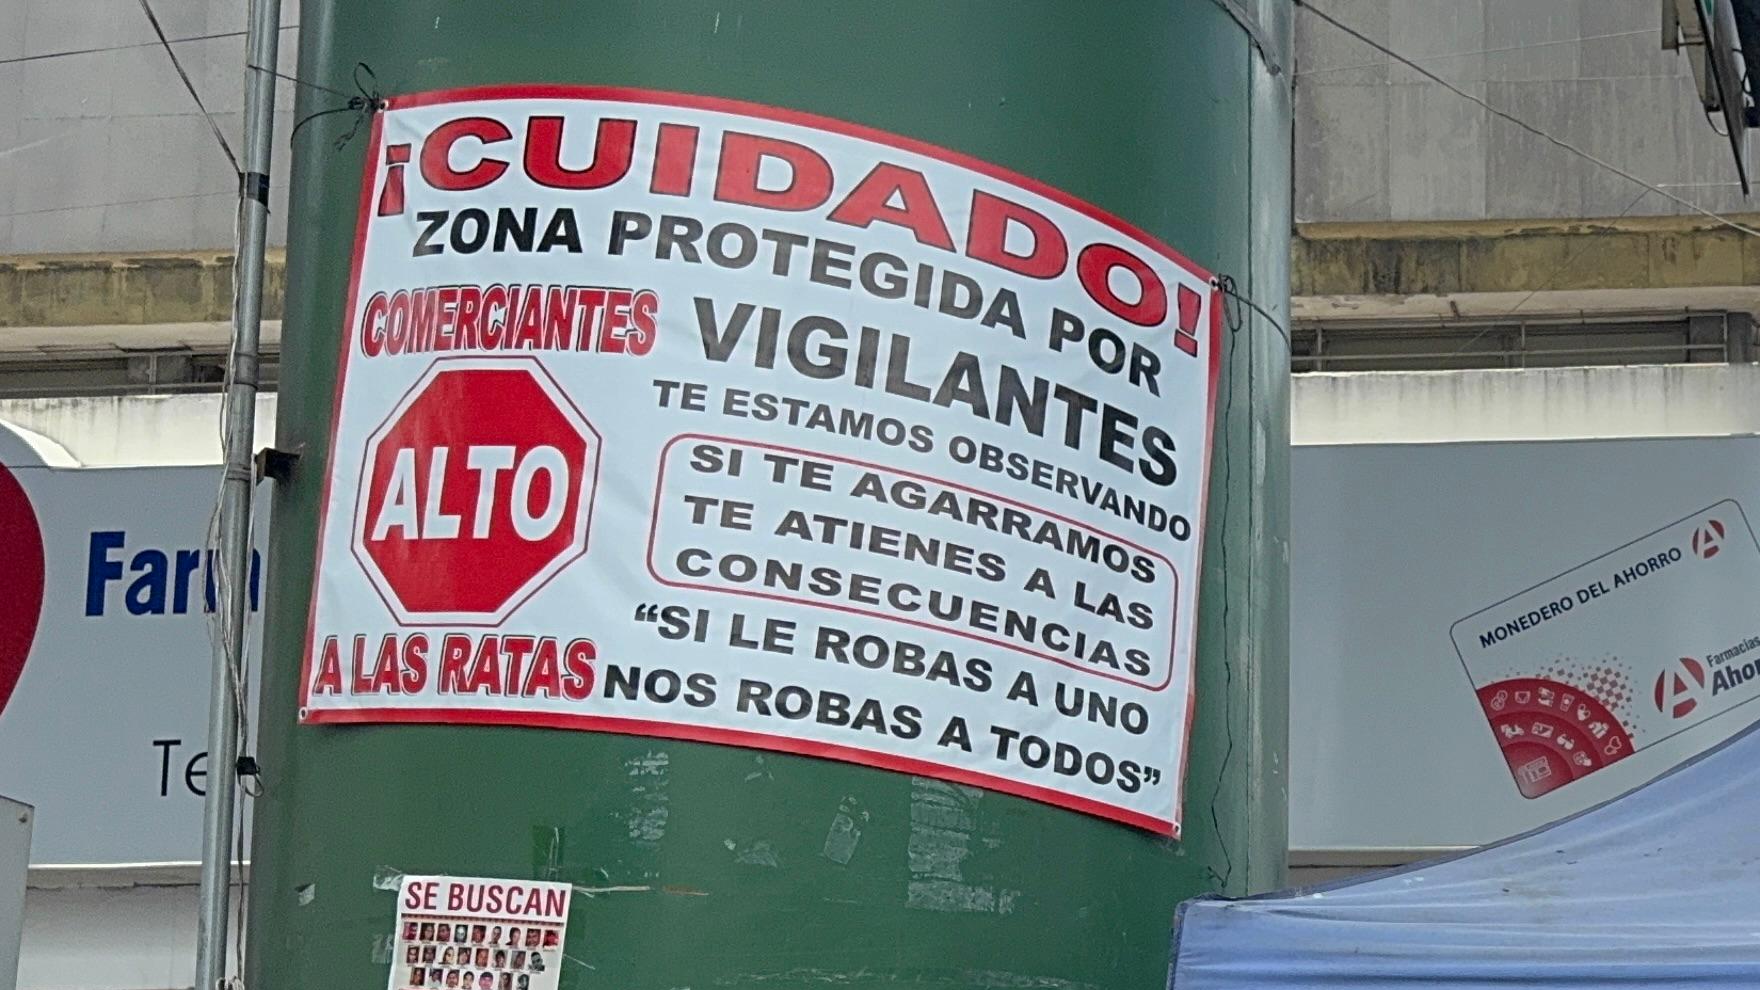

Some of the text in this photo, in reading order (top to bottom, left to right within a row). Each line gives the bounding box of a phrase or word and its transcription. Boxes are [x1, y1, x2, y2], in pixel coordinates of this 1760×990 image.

[377, 115, 1200, 359] ¡CUIDADO!
[412, 208, 1163, 397] ZONA PROTEGIDA POR
[360, 284, 660, 359] COMERCIANTES
[692, 296, 1178, 487] VIGILANTES
[373, 443, 569, 542] ALTO
[652, 379, 1191, 542] TE ESTAMOS OBSERVANDO
[690, 444, 1156, 584] SI TE AGARRAMOS
[676, 548, 1152, 677] CONSECUENCIAS
[684, 495, 1155, 631] TE ATIENES A LAS
[1479, 547, 1682, 648] MONEDERO DEL AHORRO
[314, 634, 597, 702] A LAS RATAS
[634, 603, 1150, 736] “SI LE ROBAS A UNO
[1706, 635, 1760, 668] Farmacias
[602, 663, 1161, 794] NOS ROBAS A TODOS”
[405, 882, 566, 918] SE BUSCAN
